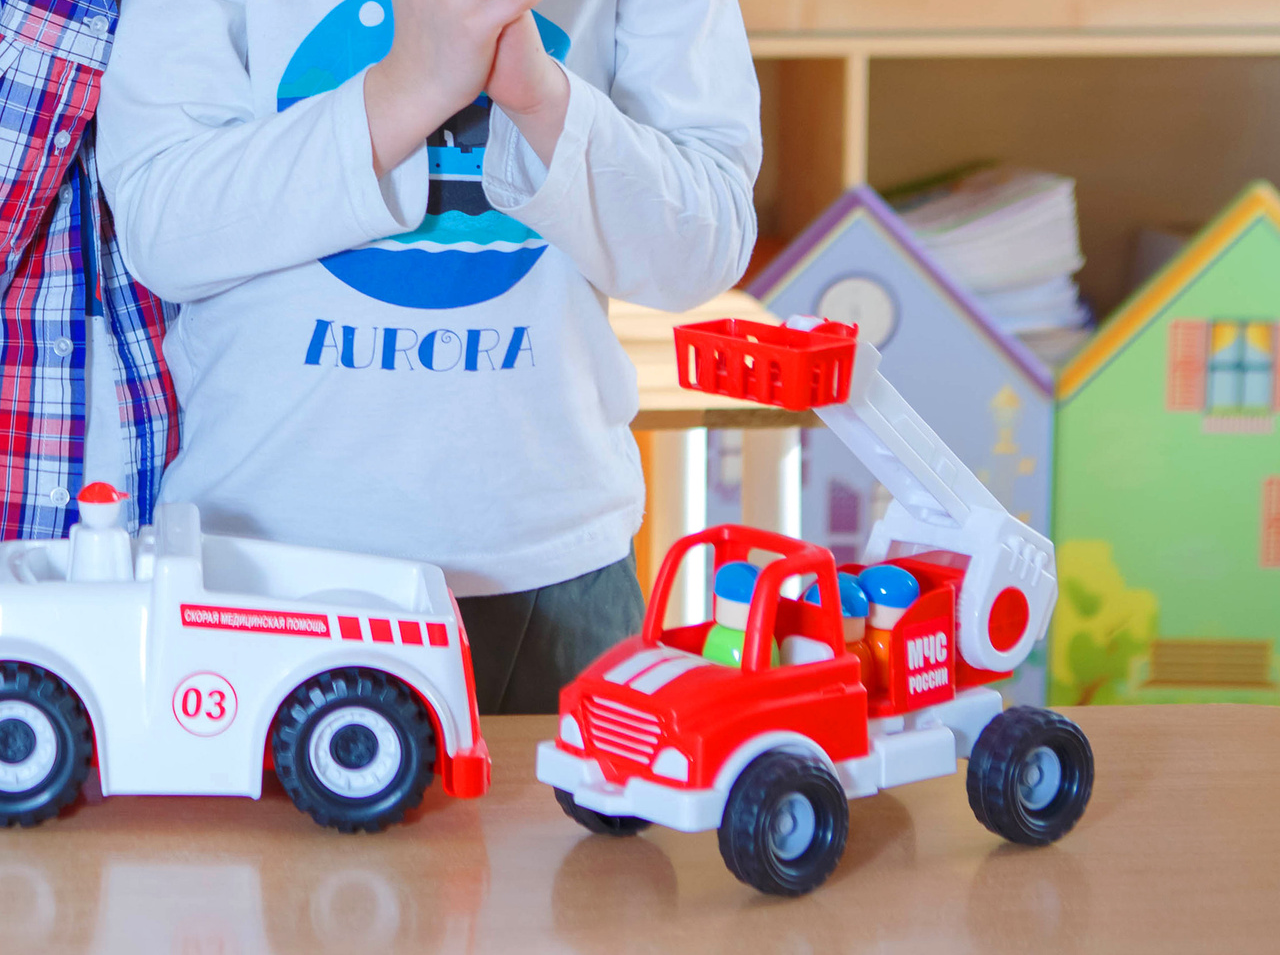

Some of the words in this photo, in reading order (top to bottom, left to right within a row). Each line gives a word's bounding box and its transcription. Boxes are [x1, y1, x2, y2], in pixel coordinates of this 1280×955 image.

[304, 319, 536, 372] AURORA
[183, 609, 219, 625] СКОРАЯ
[220, 612, 286, 630] МЕДИЦИНСКАЯ
[287, 617, 327, 634] ПОМОЩЬ
[907, 631, 948, 670] МЧС
[908, 666, 949, 695] РОССИИ
[182, 688, 226, 720] 03
